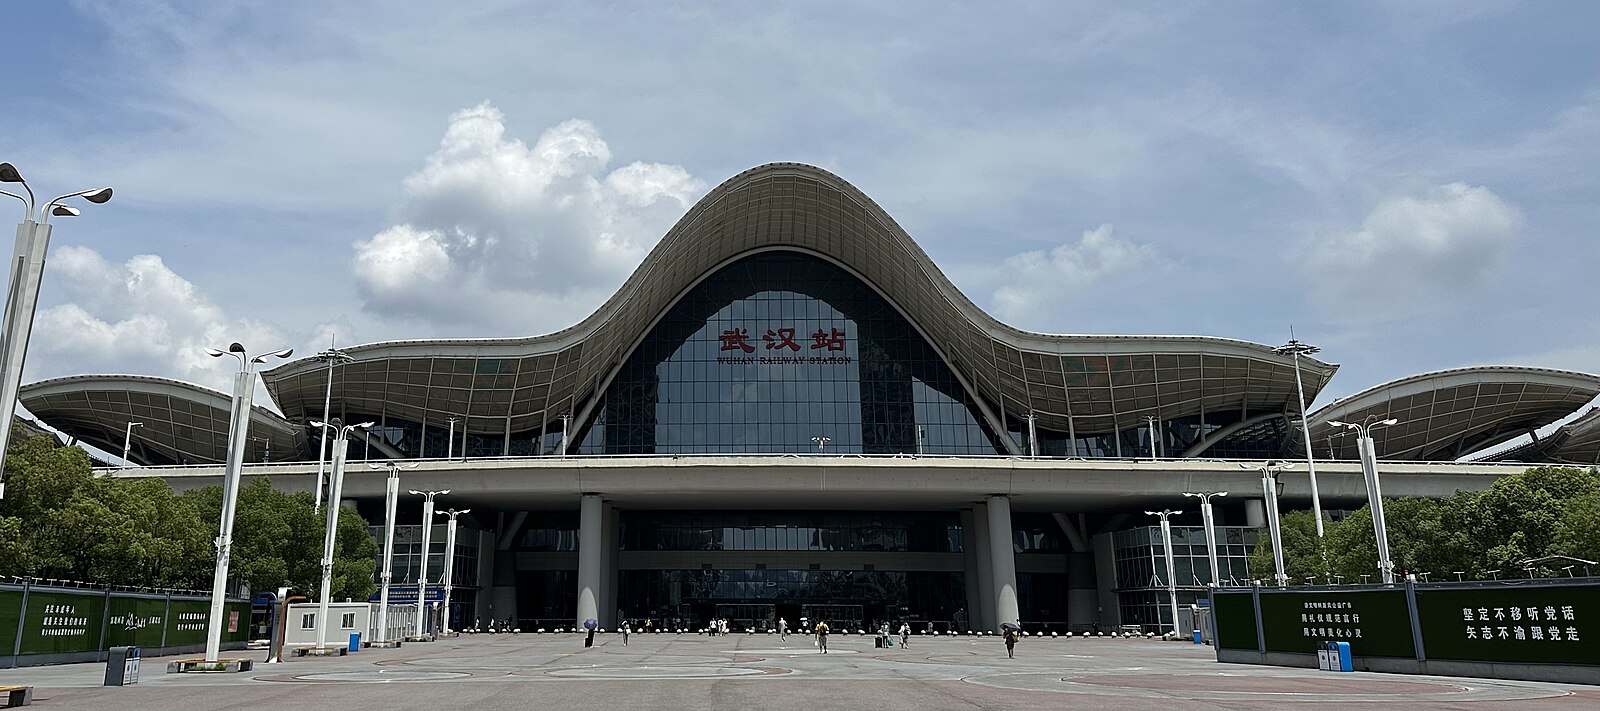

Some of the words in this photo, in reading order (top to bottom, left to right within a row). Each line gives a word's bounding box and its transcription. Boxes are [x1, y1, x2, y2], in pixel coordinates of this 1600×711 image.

[719, 328, 846, 353] 武汉站
[717, 357, 754, 365] WUHAN
[760, 357, 805, 365] RAILWAY
[809, 357, 851, 365] STATION
[1462, 605, 1575, 621] 坚定不移听党话
[1466, 625, 1580, 641] 矢志不渝跟党走
